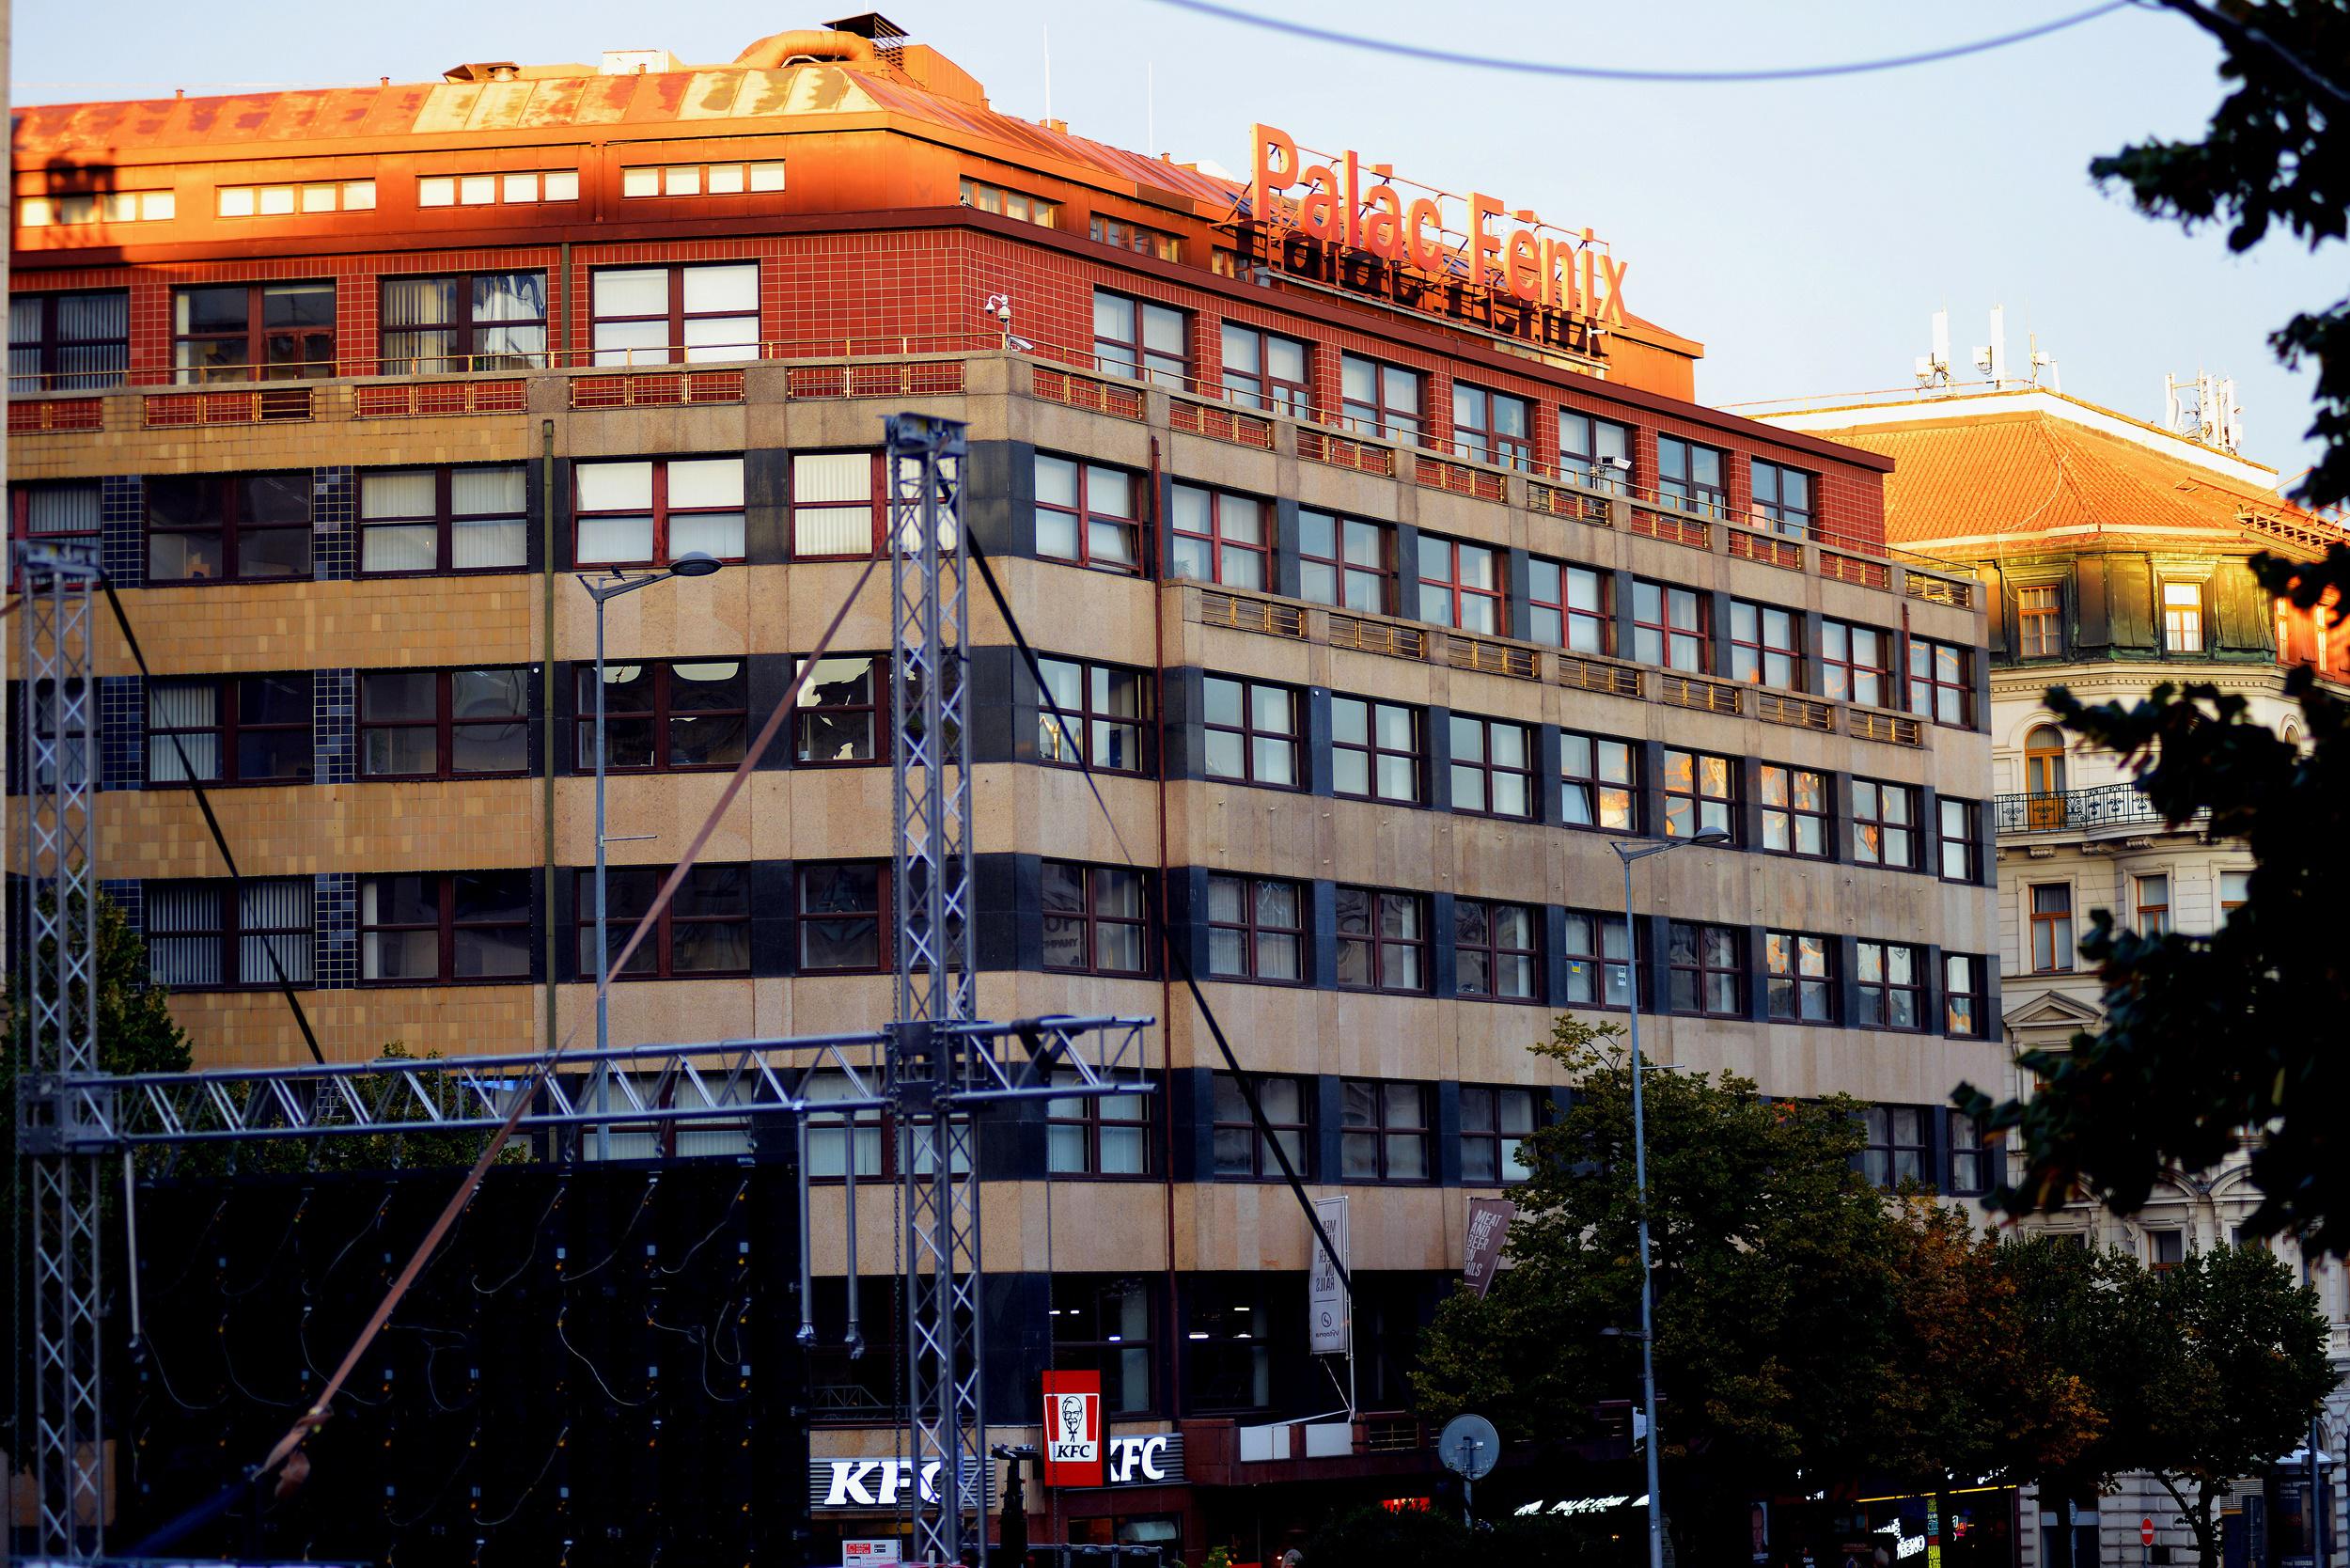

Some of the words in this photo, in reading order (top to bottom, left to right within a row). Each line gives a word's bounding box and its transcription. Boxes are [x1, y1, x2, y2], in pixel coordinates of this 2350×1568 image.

[1250, 123, 1443, 272] Palác
[1467, 192, 1629, 329] Fénix
[1475, 1209, 1502, 1228] MEAT
[1469, 1222, 1491, 1238] AND
[1466, 1234, 1489, 1251] BEER
[1464, 1262, 1482, 1278] AILS
[1057, 1445, 1090, 1459] KFC
[823, 1461, 943, 1505] KFC
